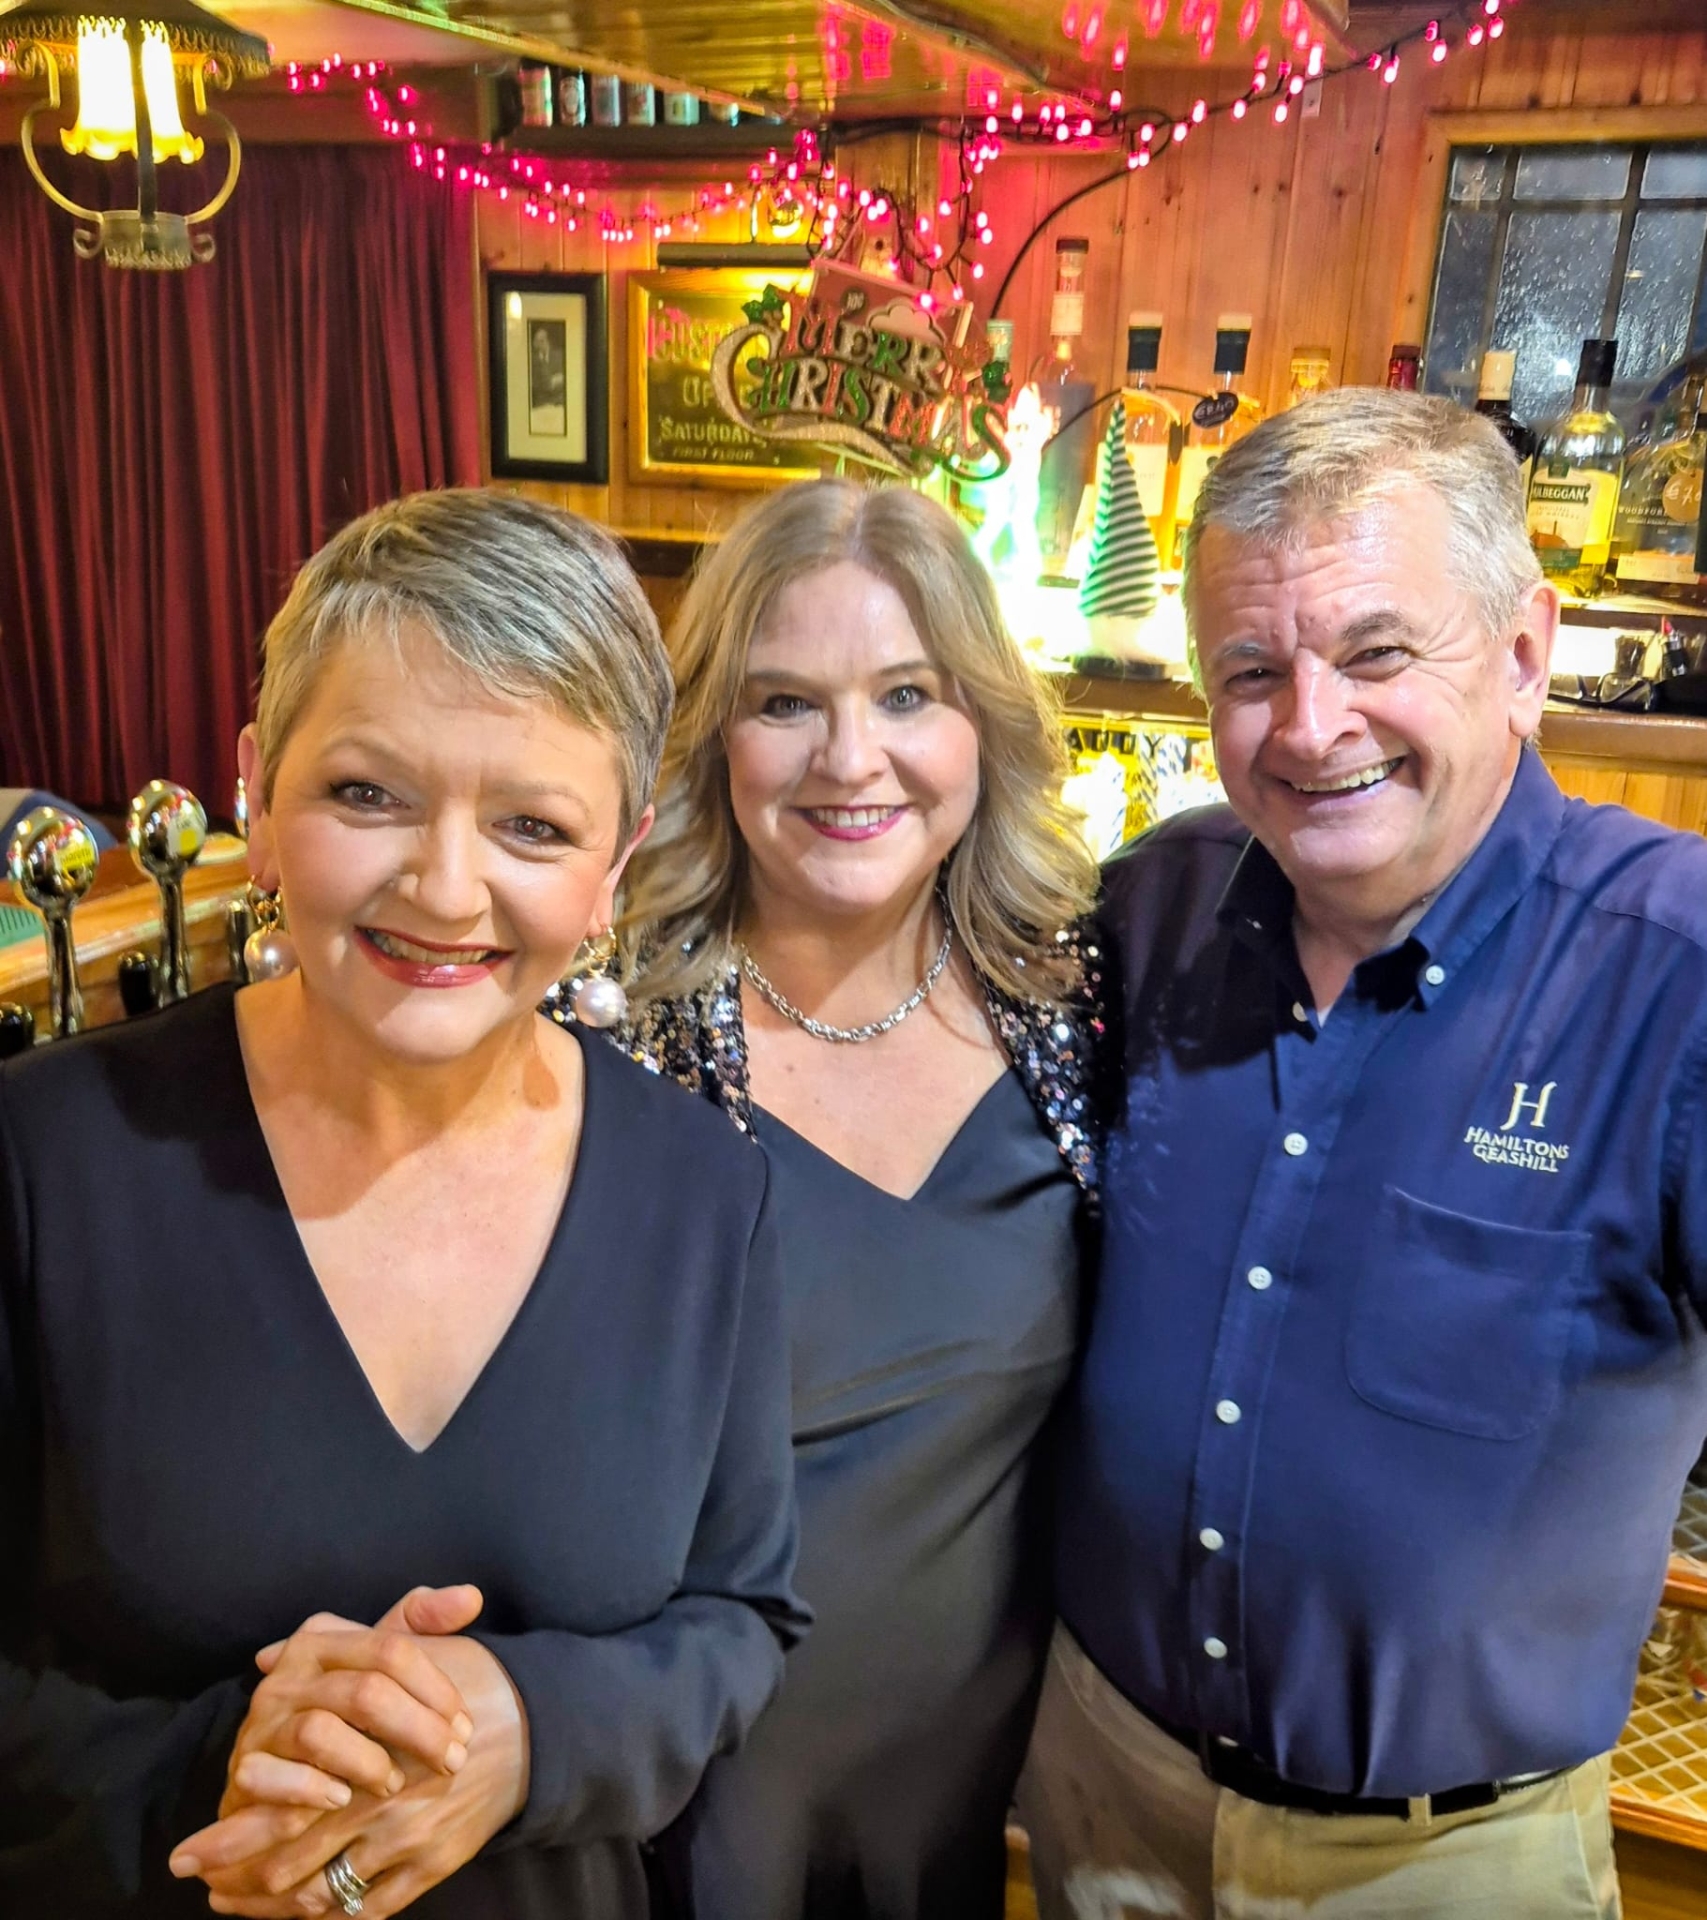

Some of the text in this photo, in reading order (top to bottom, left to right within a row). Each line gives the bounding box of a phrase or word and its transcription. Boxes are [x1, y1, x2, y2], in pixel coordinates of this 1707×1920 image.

[710, 325, 1013, 482] CHRISTMAS
[1618, 505, 1668, 517] WOODFOR
[1463, 1126, 1570, 1159] HAMILTONS
[1473, 1143, 1559, 1172] GEASHILL
